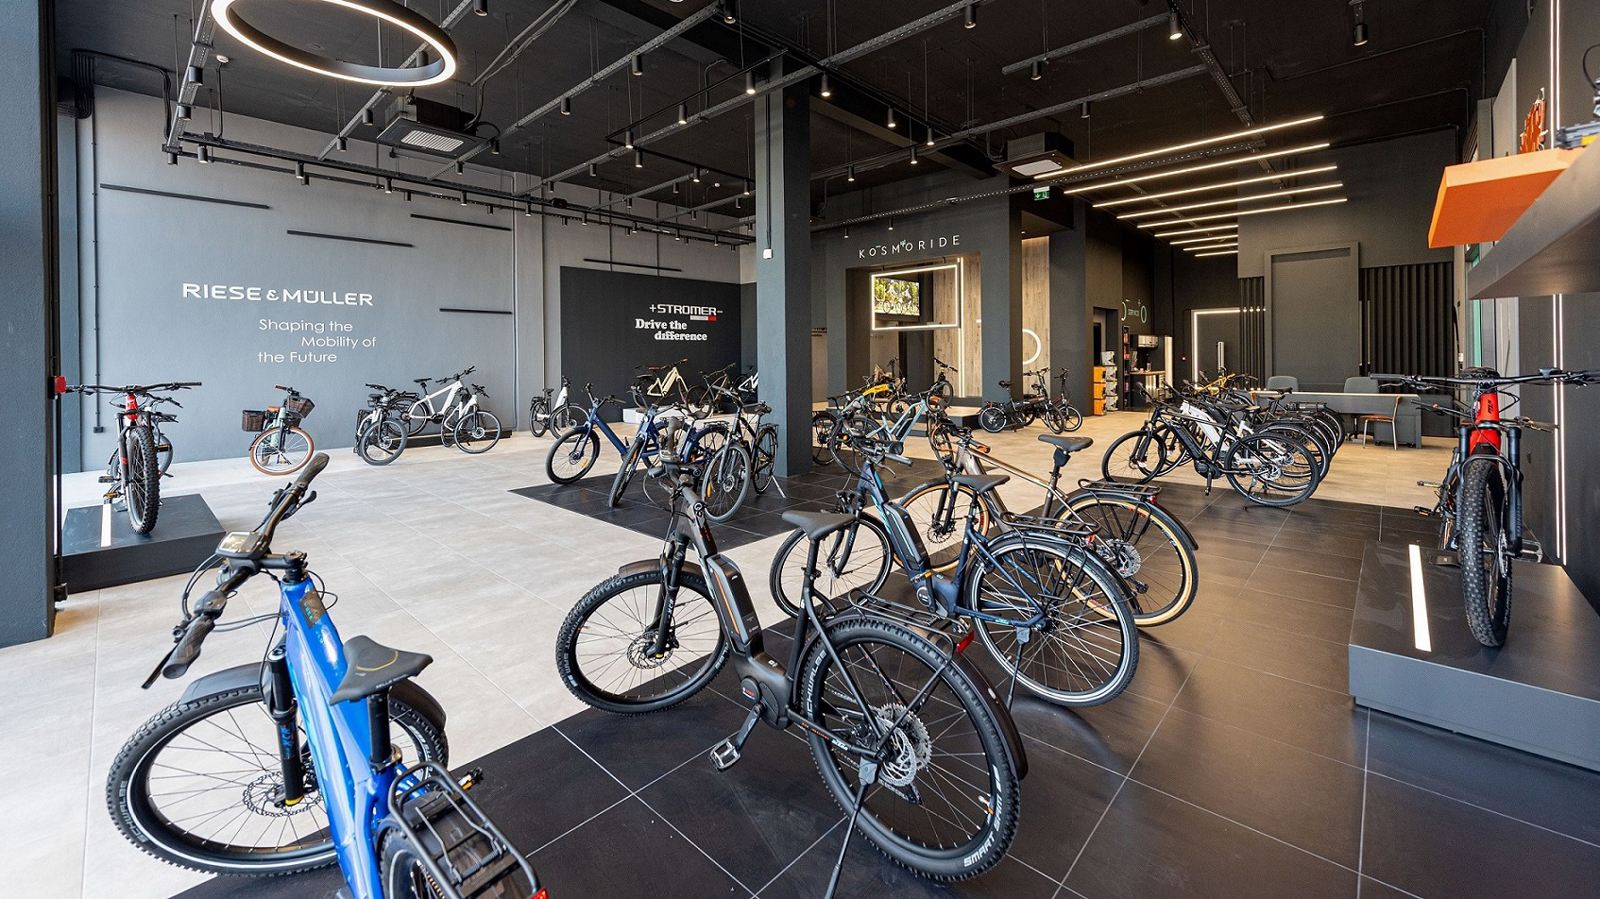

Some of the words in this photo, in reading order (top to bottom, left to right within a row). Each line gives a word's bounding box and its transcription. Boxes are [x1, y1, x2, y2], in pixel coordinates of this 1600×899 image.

[182, 283, 262, 301] RIESE
[266, 289, 279, 301] &
[282, 288, 374, 306] MÜLLER
[258, 318, 325, 334] Shaping
[329, 320, 353, 332] the
[635, 318, 668, 330] Drive
[669, 320, 687, 330] the
[301, 336, 359, 349] Mobility
[362, 336, 377, 348] of
[654, 330, 708, 341] difference
[257, 351, 285, 363] the
[290, 351, 338, 363] Future
[118, 780, 149, 843] SCHWALBE
[963, 830, 996, 868] SMART
[993, 792, 1003, 832] SAM
